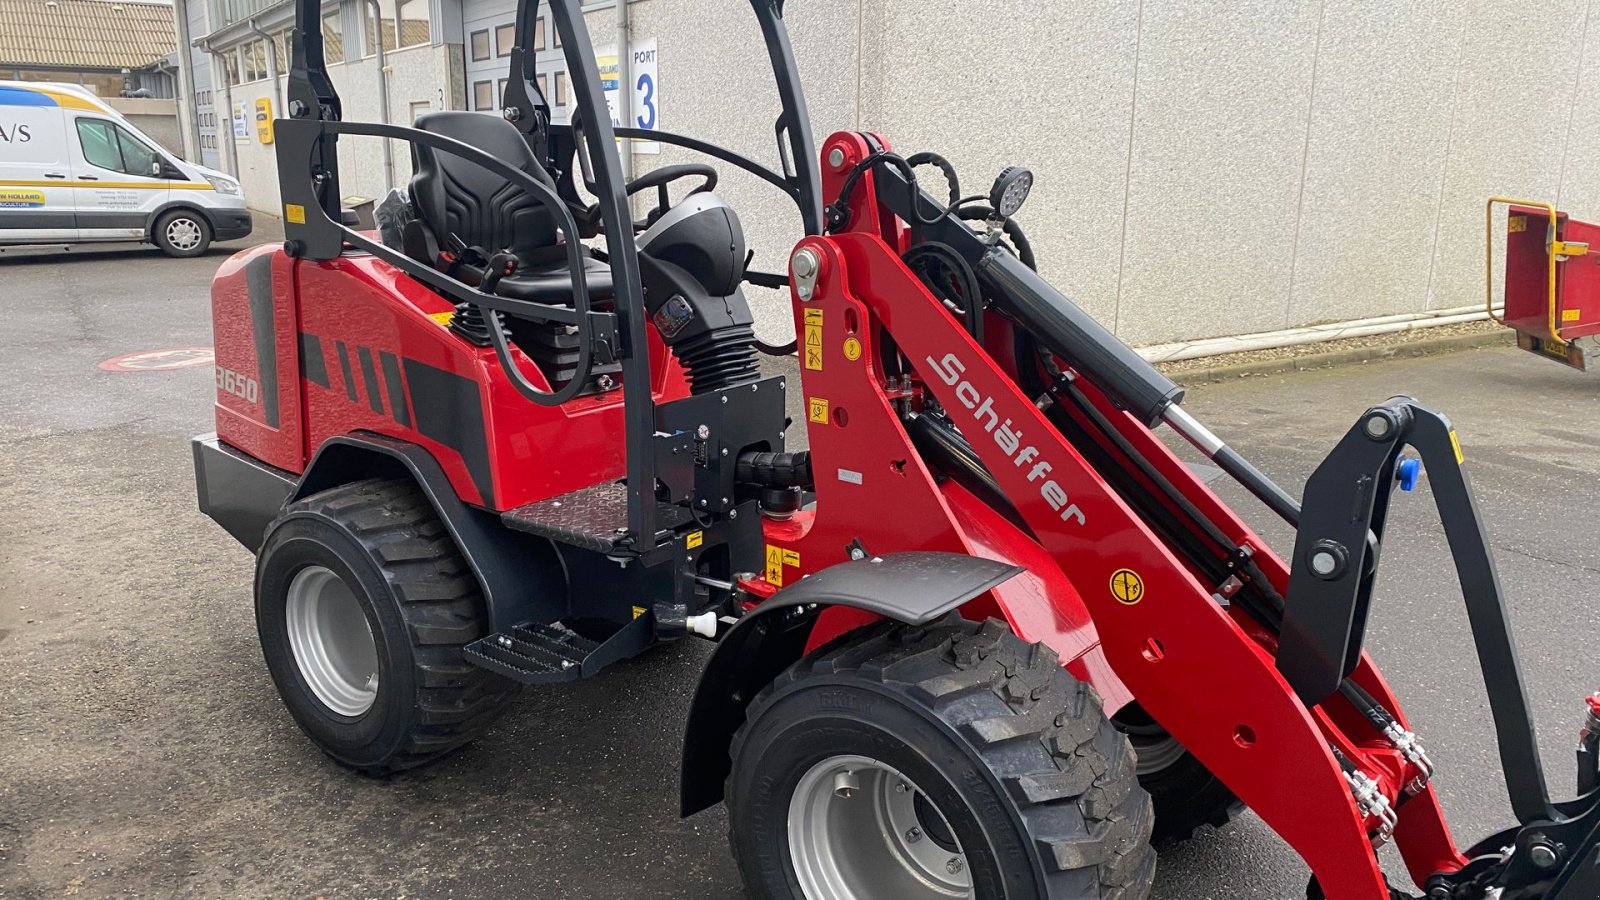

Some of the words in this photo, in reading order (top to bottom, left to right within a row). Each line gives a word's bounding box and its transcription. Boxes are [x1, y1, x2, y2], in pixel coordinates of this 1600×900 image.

[634, 50, 656, 64] PORT
[637, 73, 656, 130] 3
[0, 123, 31, 143] A/S
[216, 365, 258, 404] 3650
[926, 353, 1086, 526] Schäffer
